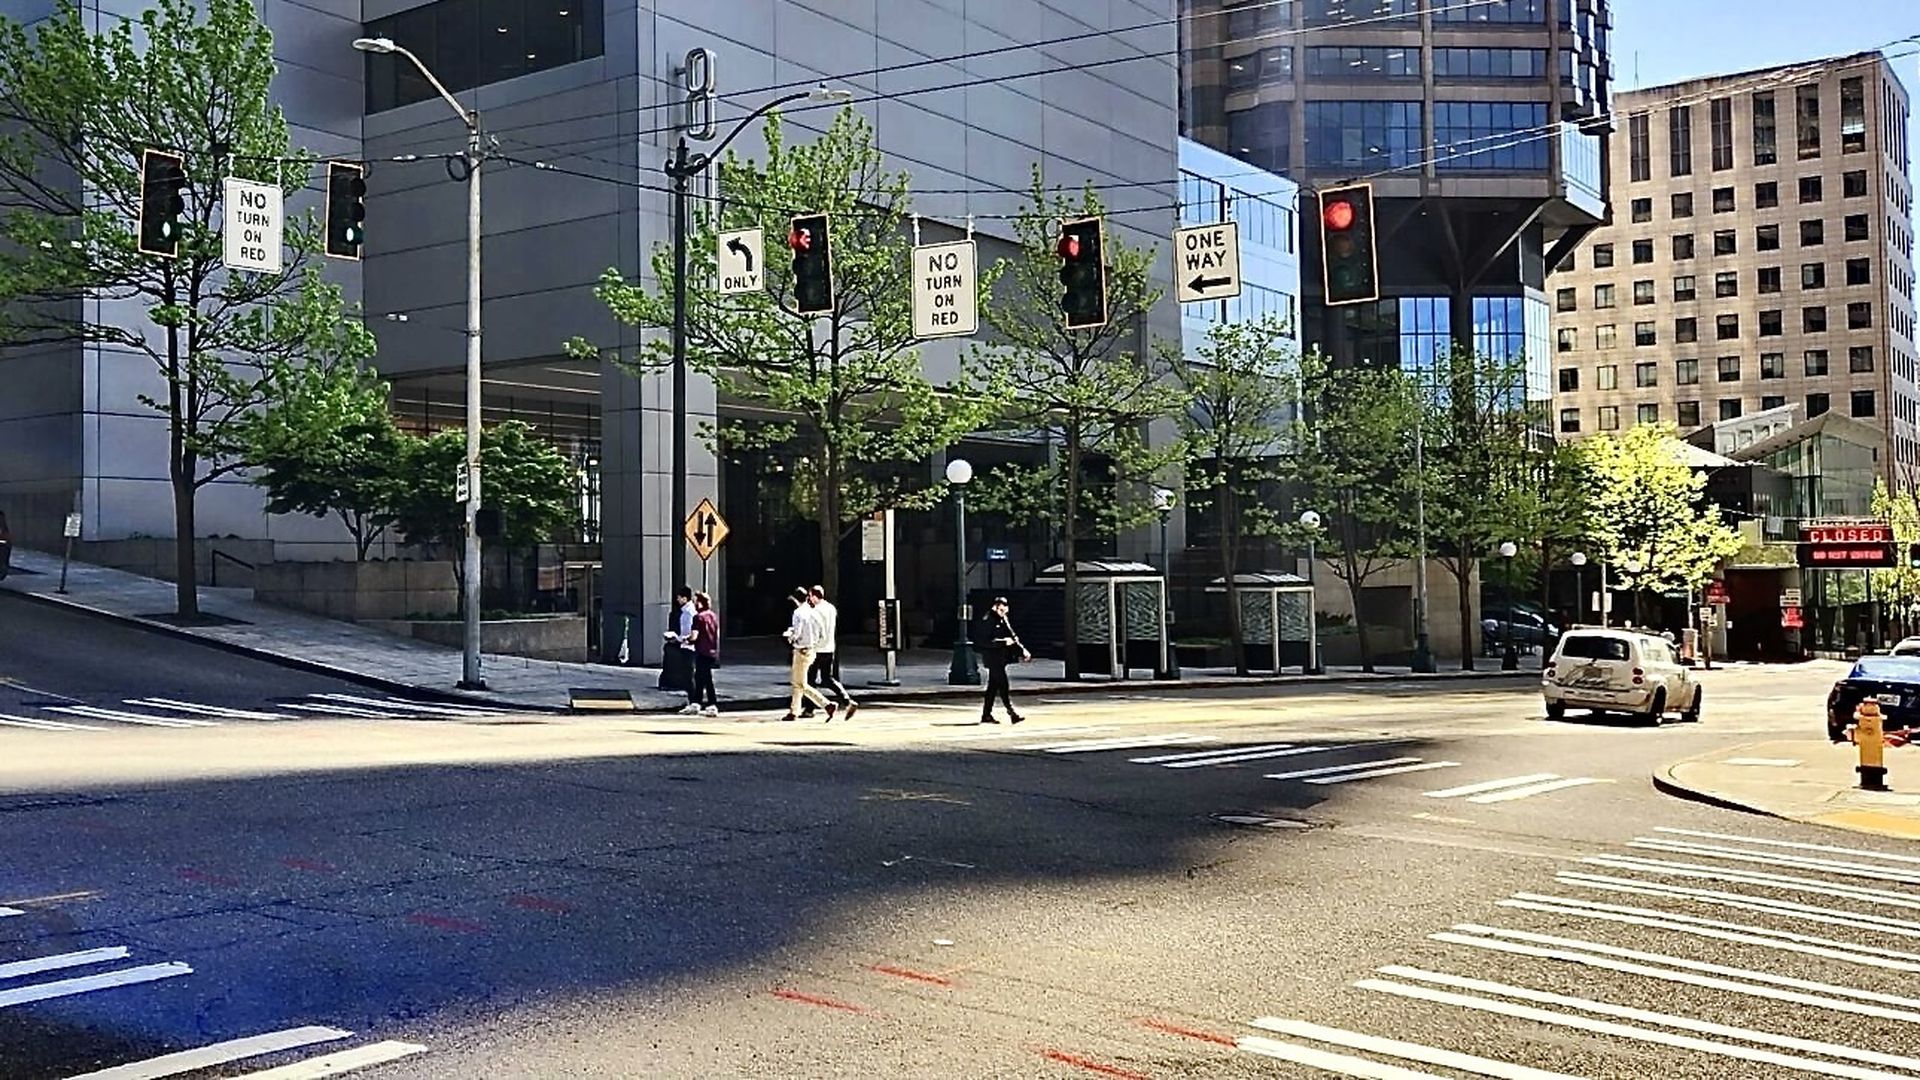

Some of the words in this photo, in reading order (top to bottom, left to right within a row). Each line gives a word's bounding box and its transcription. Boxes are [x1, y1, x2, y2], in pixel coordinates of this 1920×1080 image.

[240, 190, 267, 210] NO
[237, 211, 270, 228] TURN
[243, 229, 262, 244] ON
[1185, 230, 1225, 251] ONE
[240, 246, 266, 262] RED
[928, 252, 959, 273] NO
[1186, 249, 1227, 270] WAY
[724, 274, 758, 290] ONLY
[925, 274, 963, 291] TURN
[934, 293, 955, 308] ON
[931, 310, 959, 327] RED
[1810, 529, 1884, 543] CLOSED
